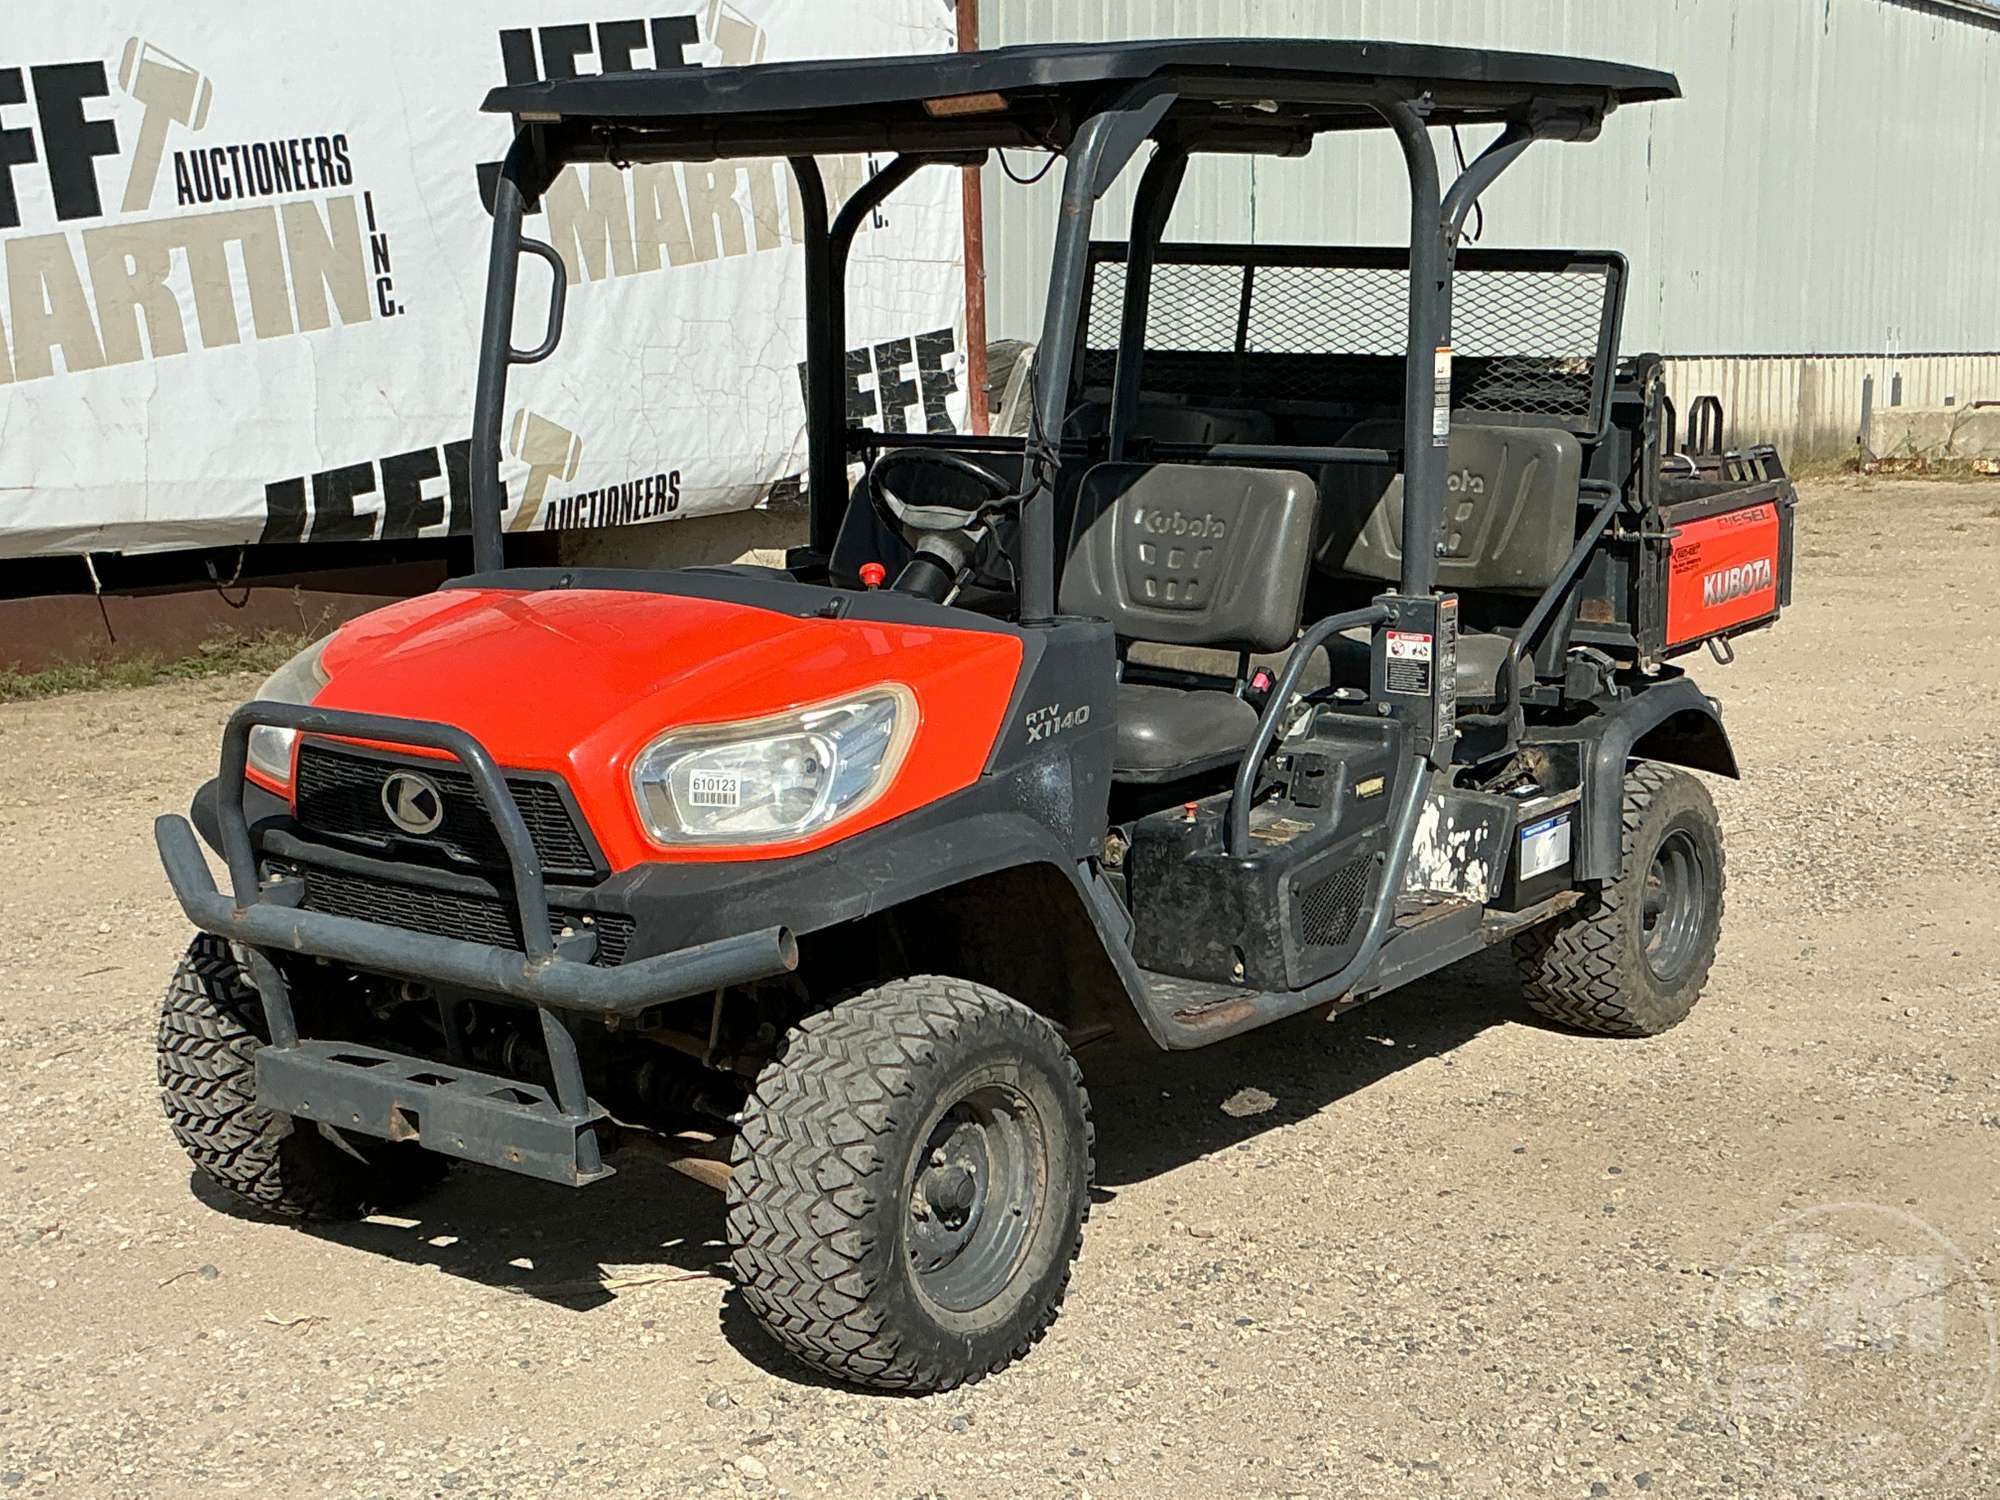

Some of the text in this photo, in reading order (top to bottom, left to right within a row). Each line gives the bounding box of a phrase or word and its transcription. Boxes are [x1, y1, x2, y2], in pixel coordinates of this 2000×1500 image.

[174, 134, 353, 206] AUCTIONEERS
[364, 191, 405, 317] INC.
[0, 195, 372, 385] ARTIN
[544, 470, 681, 530] AUCTIONEERS
[1717, 508, 1771, 530] DIESEL
[1133, 509, 1226, 539] Kubota
[1703, 559, 1771, 608] KUBOTA
[1025, 705, 1090, 745] X1140
[1026, 703, 1060, 726] RTV
[693, 778, 737, 792] 610123
